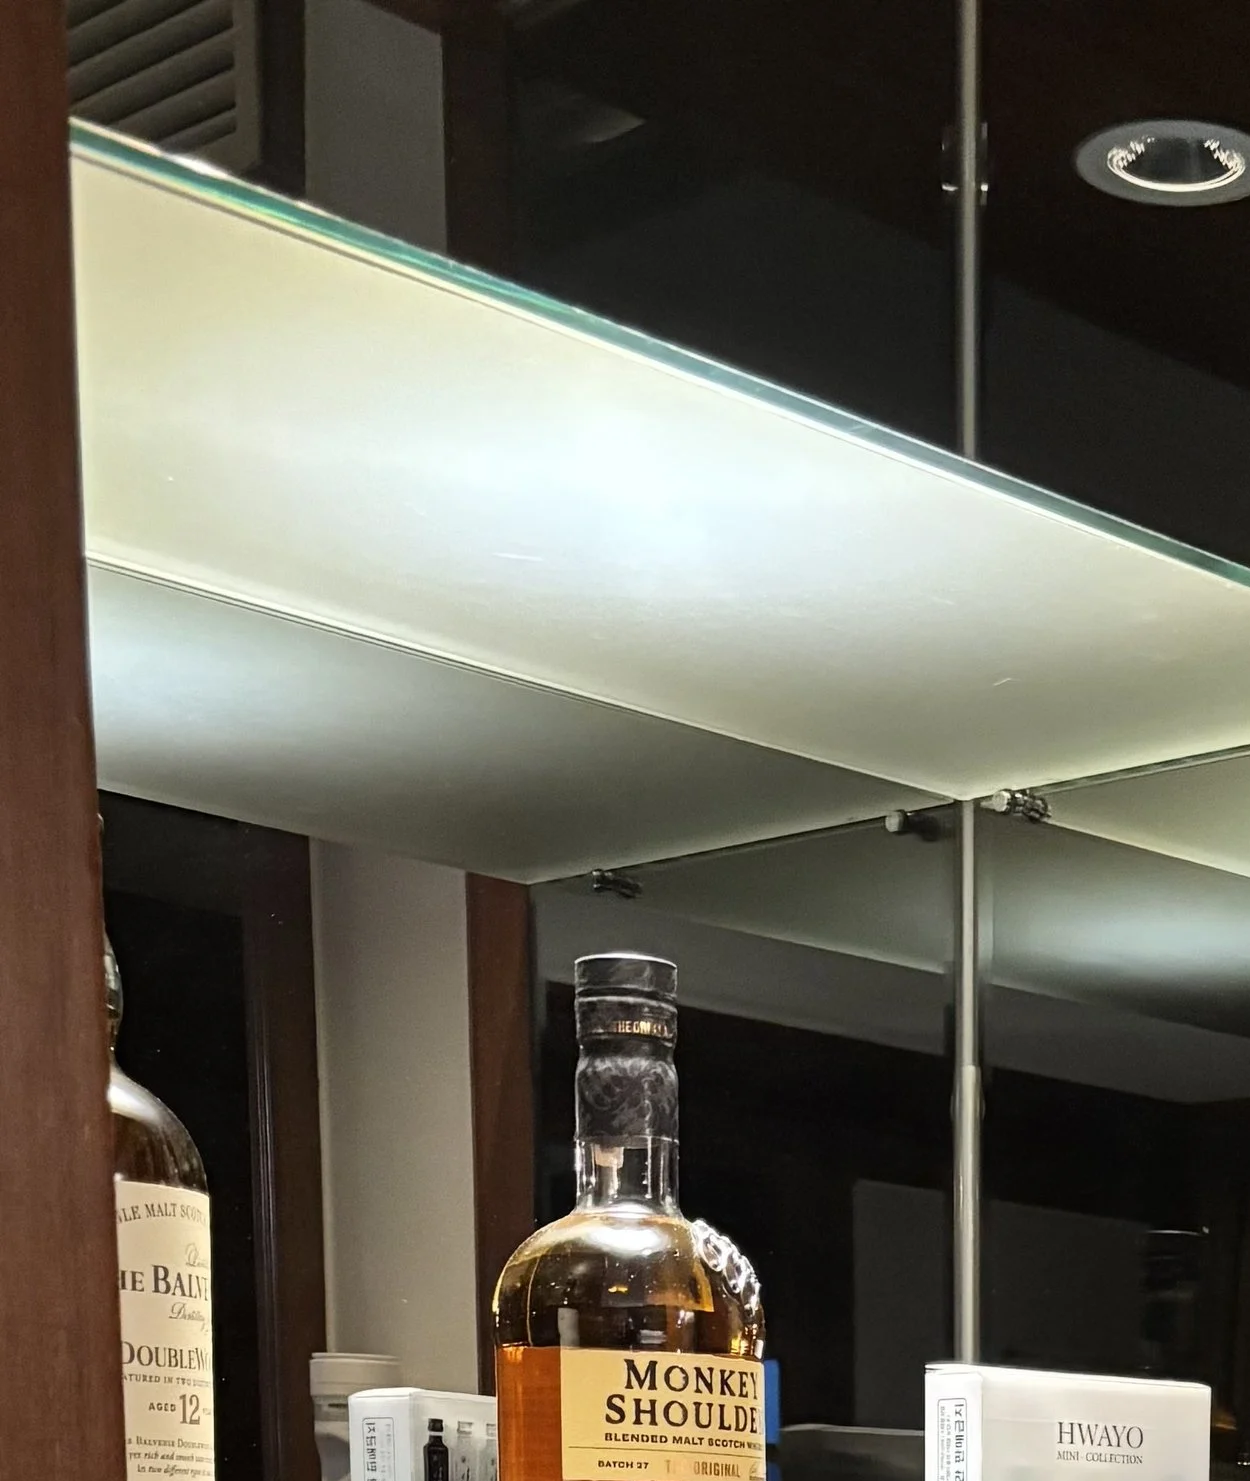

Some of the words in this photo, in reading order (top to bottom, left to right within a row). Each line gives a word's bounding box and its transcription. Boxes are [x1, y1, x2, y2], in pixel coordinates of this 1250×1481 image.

[144, 1202, 177, 1218] MALT
[624, 1358, 758, 1400] MONKEY
[148, 1402, 176, 1412] AGED
[179, 1393, 200, 1425] 12
[604, 1432, 668, 1444] BLENDED
[672, 1436, 705, 1446] MALT
[707, 1438, 746, 1449] SCOTCH
[1056, 1421, 1144, 1449] HWAYO
[597, 1460, 634, 1470] BATCH
[1056, 1450, 1080, 1461] MINI
[1085, 1452, 1143, 1465] COLLECTION
[693, 1460, 742, 1478] ORIGINAL
